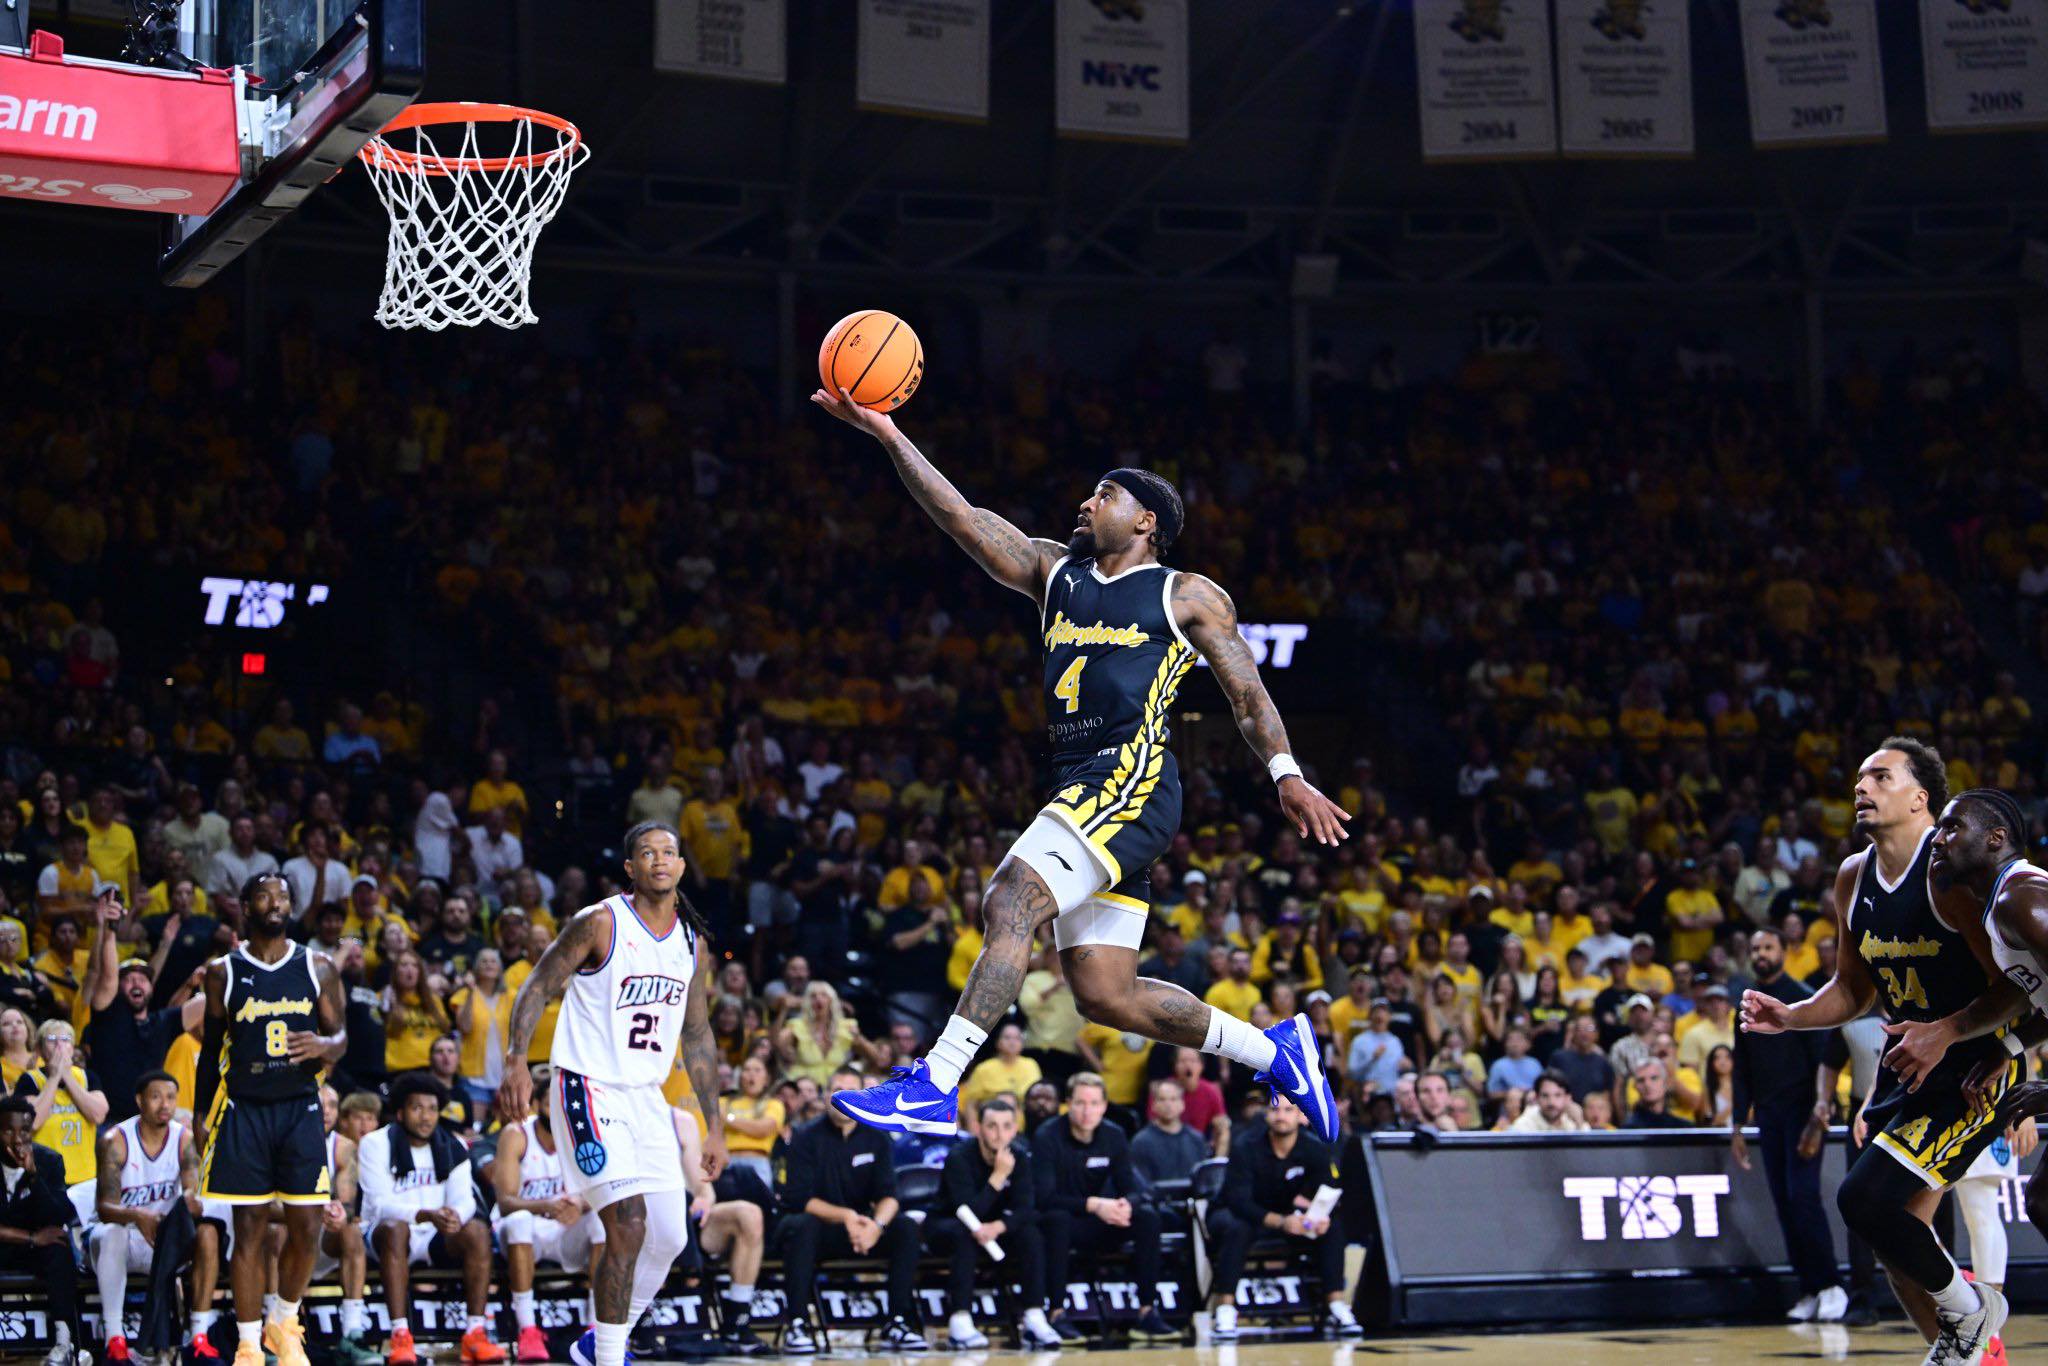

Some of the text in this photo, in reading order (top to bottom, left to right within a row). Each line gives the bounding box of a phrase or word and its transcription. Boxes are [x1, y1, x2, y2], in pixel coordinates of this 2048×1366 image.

[1967, 90, 2024, 114] 2008
[1599, 117, 1656, 142] 2005
[1789, 104, 1846, 130] 2007
[1460, 120, 1518, 144] 2004
[1054, 656, 1088, 713] 4
[1056, 716, 1104, 736] DYNAMO
[616, 975, 686, 1010] DRIVE
[1879, 967, 1930, 1010] 34
[265, 1020, 289, 1057] 8
[61, 1120, 83, 1147] 21
[1563, 1174, 1730, 1241] TBT
